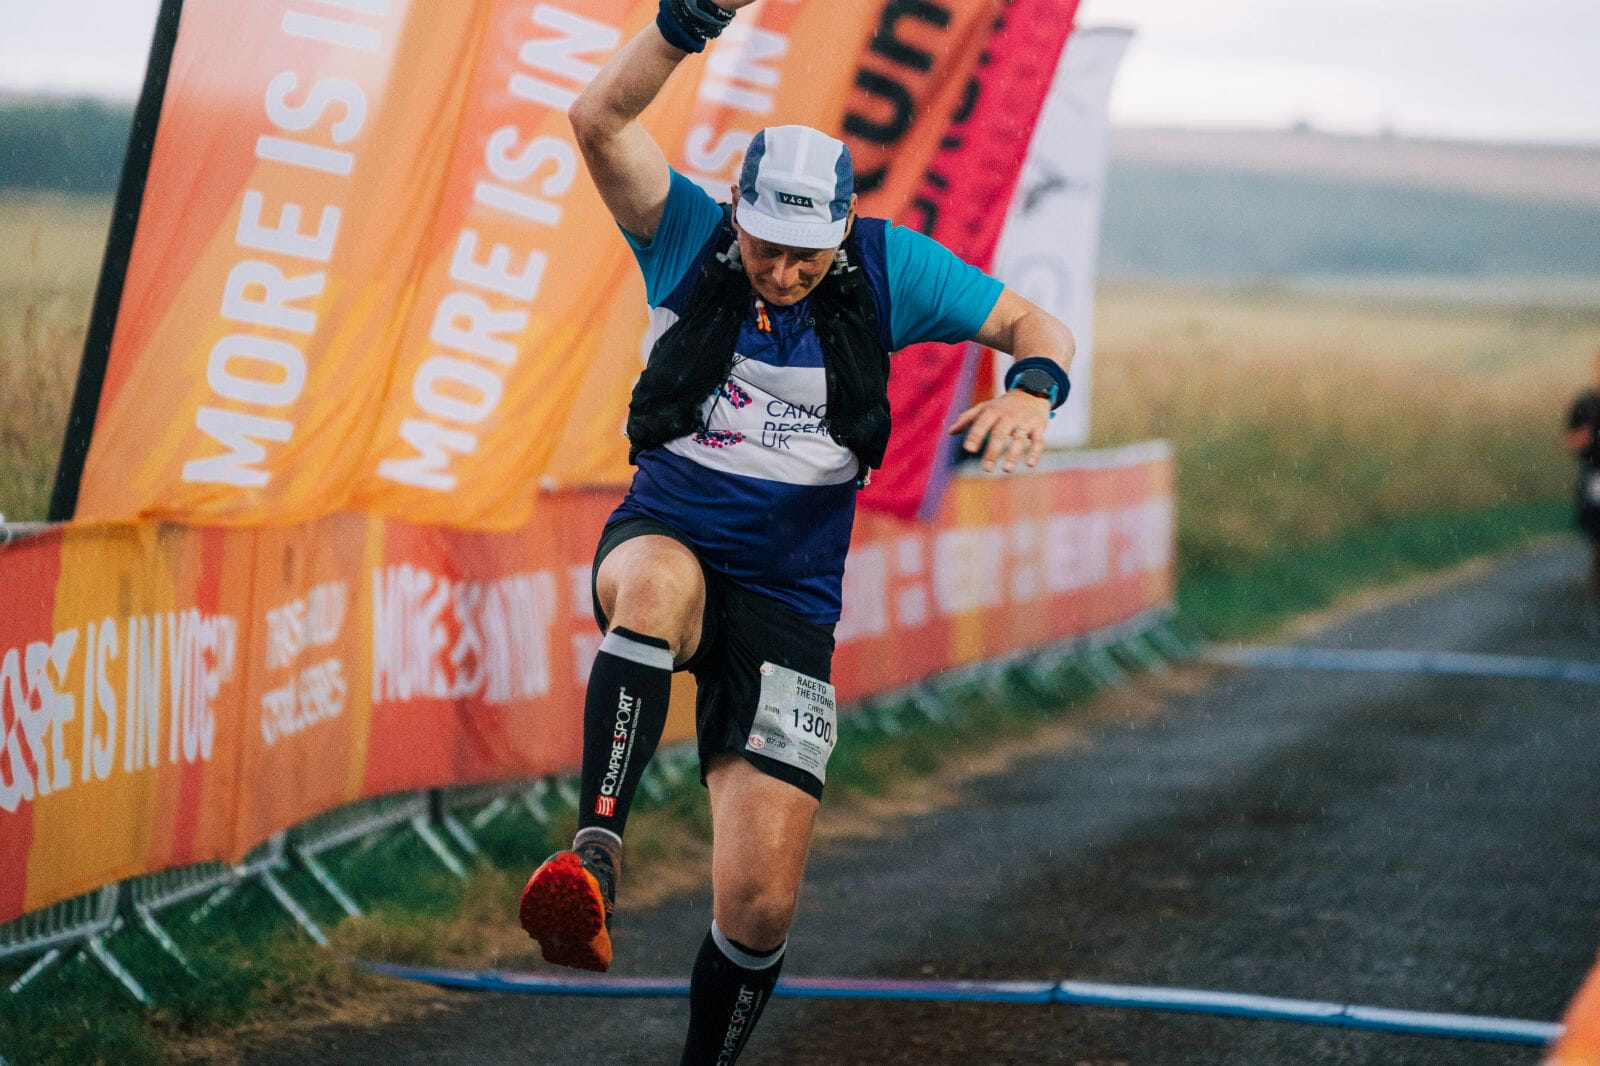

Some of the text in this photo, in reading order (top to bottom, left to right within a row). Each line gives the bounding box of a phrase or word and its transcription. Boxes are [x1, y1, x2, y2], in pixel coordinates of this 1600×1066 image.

[508, 3, 622, 112] IN
[255, 72, 367, 176] IS
[473, 126, 577, 226] IS
[182, 191, 340, 488] MORE
[377, 230, 548, 492] MORE
[761, 431, 791, 450] UK
[82, 617, 119, 783] IS
[123, 612, 163, 774] IN
[792, 708, 832, 743] 1300
[796, 676, 827, 695] RACE TO
[796, 686, 811, 699] THE
[766, 736, 786, 749] 07:30
